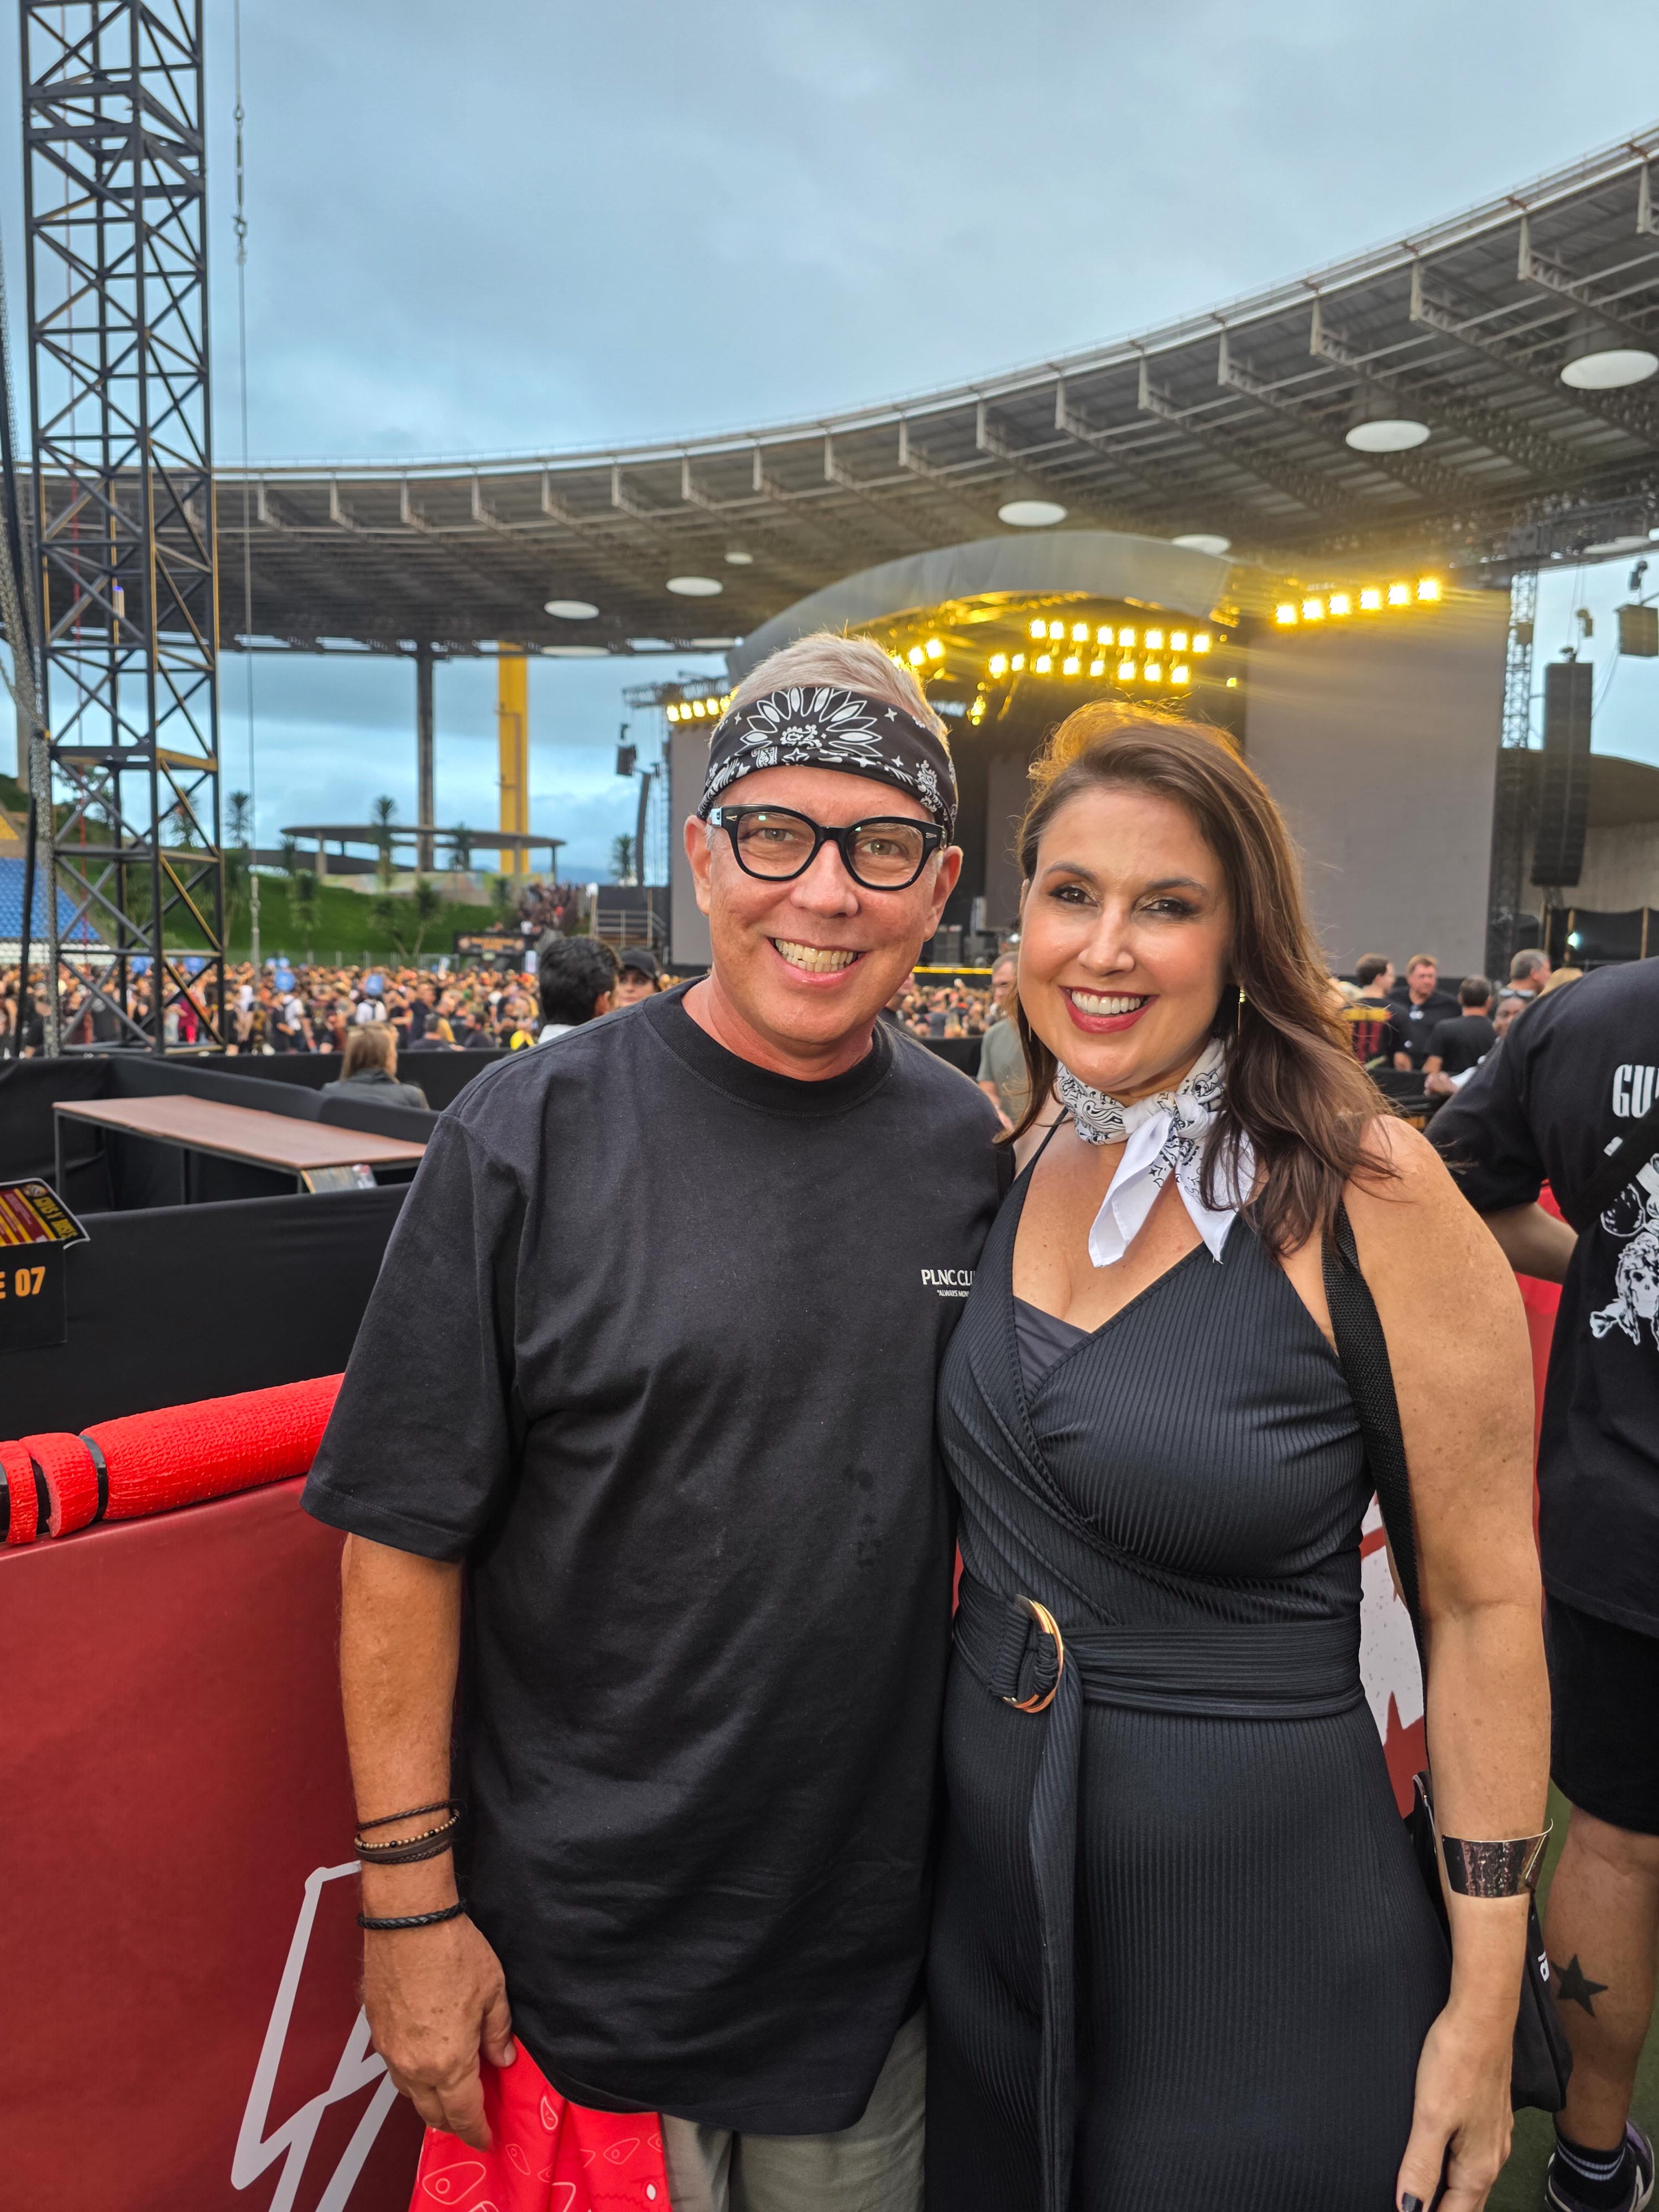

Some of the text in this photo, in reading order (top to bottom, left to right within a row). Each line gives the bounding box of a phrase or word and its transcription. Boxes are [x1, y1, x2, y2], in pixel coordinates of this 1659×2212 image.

[1612, 1064, 1659, 1118] GU
[15, 1266, 46, 1297] 07
[921, 1269, 957, 1285] PLNC
